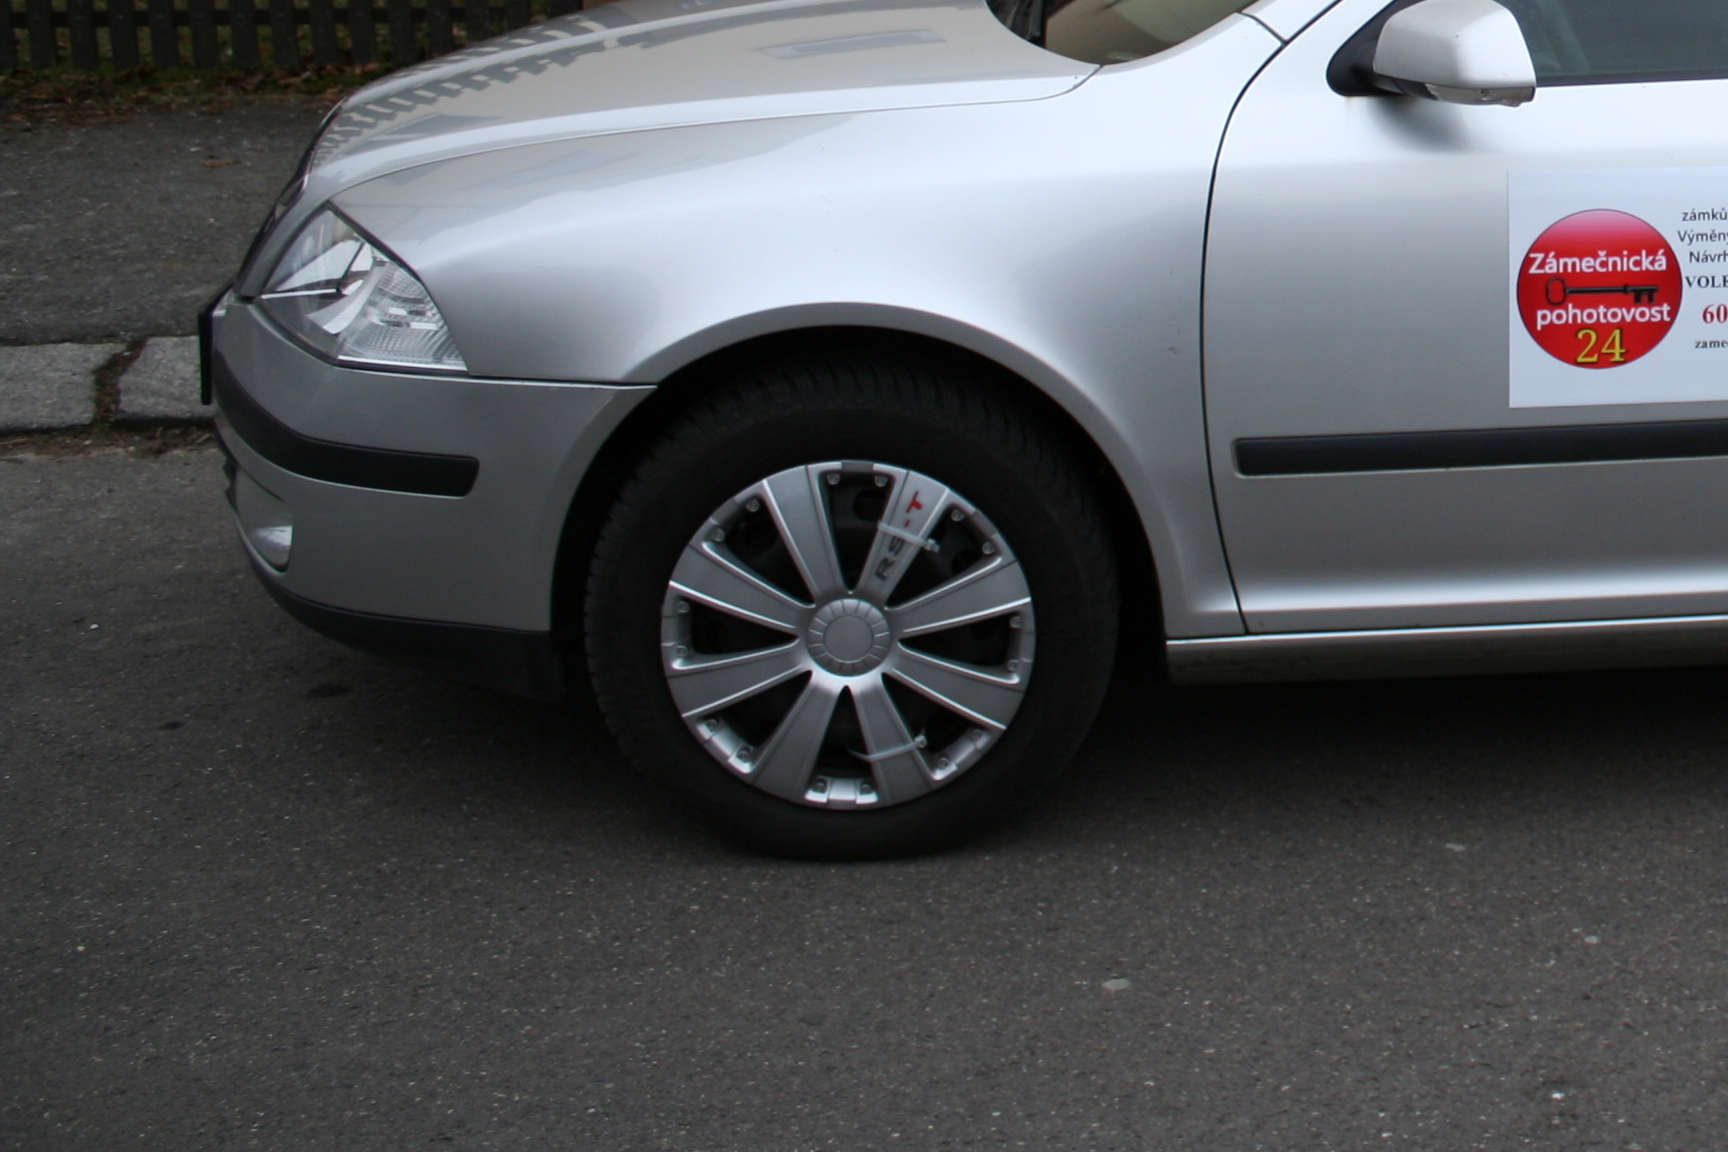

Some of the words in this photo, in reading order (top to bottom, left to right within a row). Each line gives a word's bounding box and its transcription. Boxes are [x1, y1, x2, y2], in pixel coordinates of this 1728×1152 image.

[1529, 249, 1667, 274] Zámečnická
[1536, 303, 1671, 331] pohotovost
[1575, 328, 1627, 363] 24
